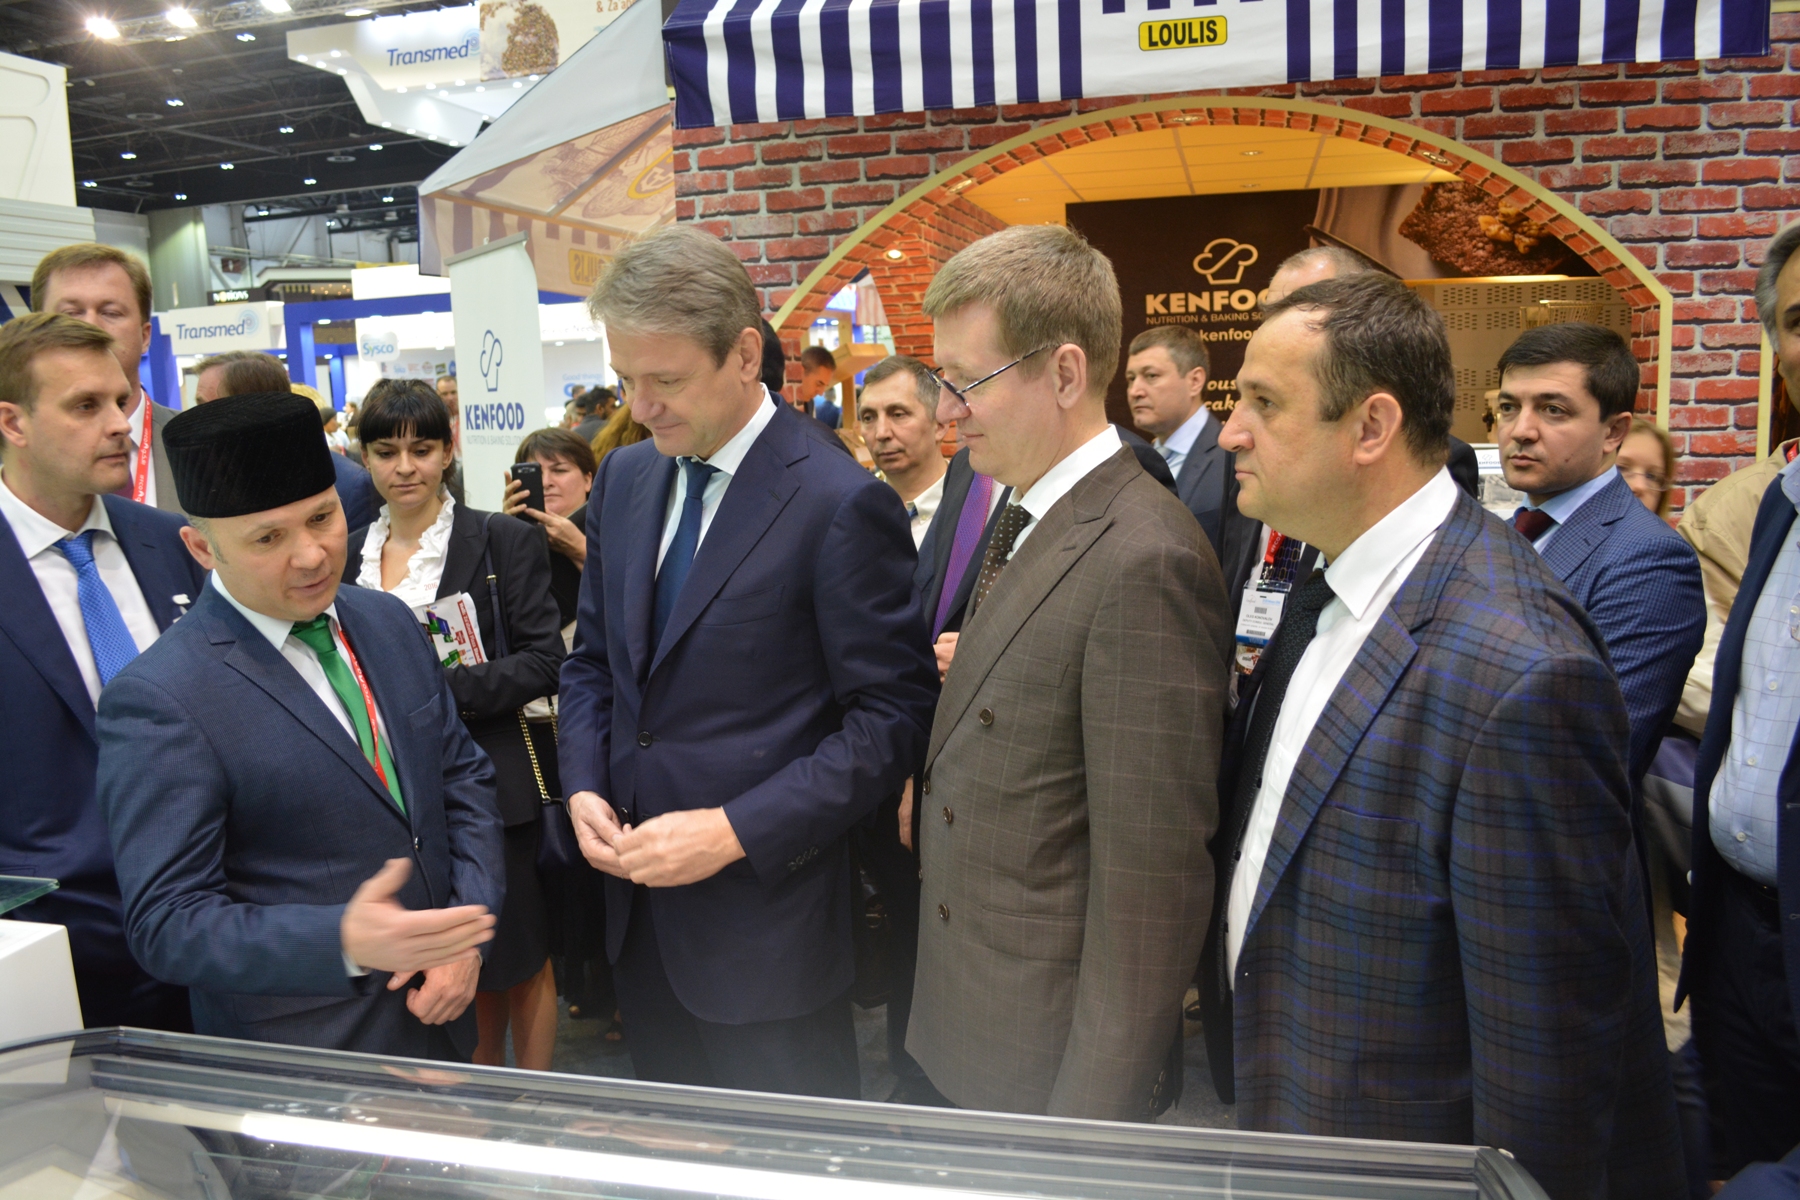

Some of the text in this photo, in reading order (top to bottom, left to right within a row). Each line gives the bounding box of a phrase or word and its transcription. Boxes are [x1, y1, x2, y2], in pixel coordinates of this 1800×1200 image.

[1147, 19, 1218, 48] LOULIS
[387, 40, 470, 66] Transmed
[1146, 314, 1198, 325] NUTRITION
[1200, 314, 1208, 322] &
[1210, 312, 1249, 322] BAKING
[176, 319, 246, 340] Transmed
[1200, 328, 1252, 342] kenfoo
[362, 342, 394, 357] Sysco
[465, 402, 524, 431] KENFOOD
[424, 582, 438, 591] 2016
